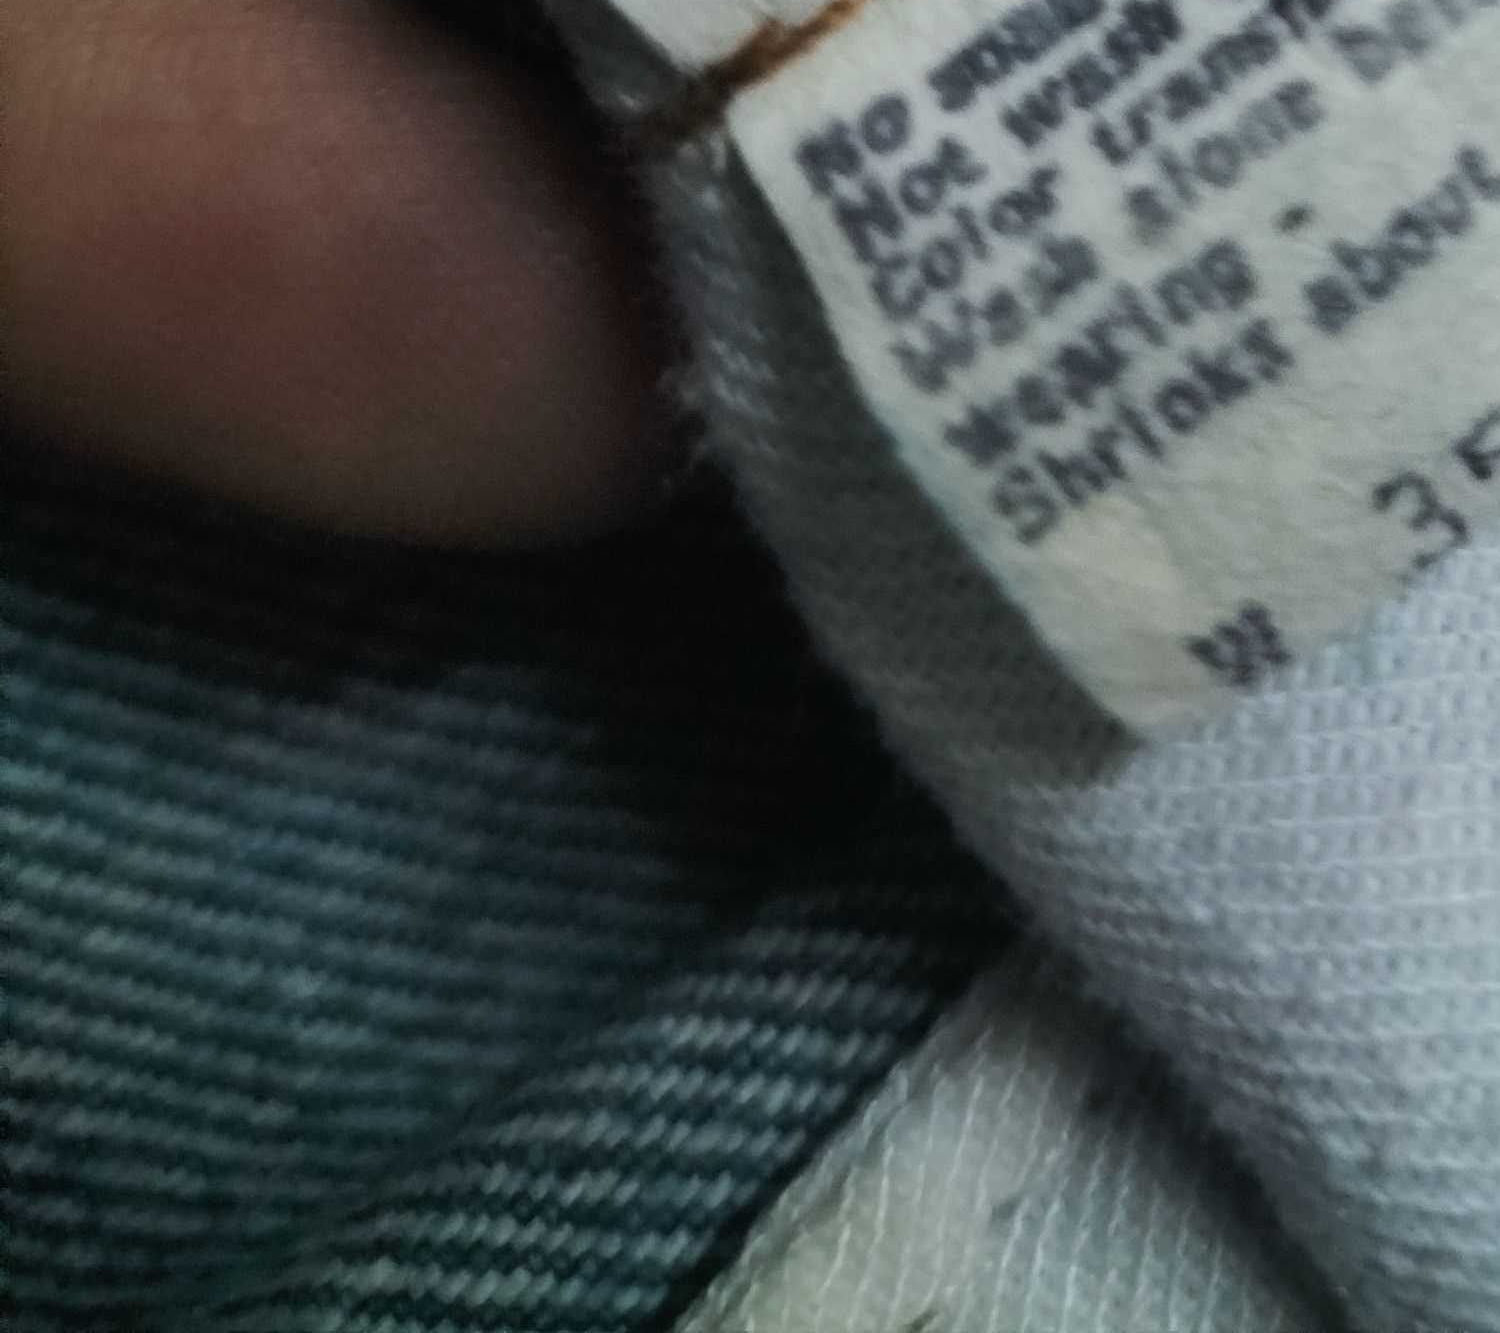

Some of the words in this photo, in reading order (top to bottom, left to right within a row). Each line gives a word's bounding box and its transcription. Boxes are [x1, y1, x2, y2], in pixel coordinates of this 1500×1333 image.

[792, 92, 912, 200] No
[1123, 79, 1323, 246] alone
[866, 162, 1061, 325] Color
[990, 296, 1294, 544] Shrinks
